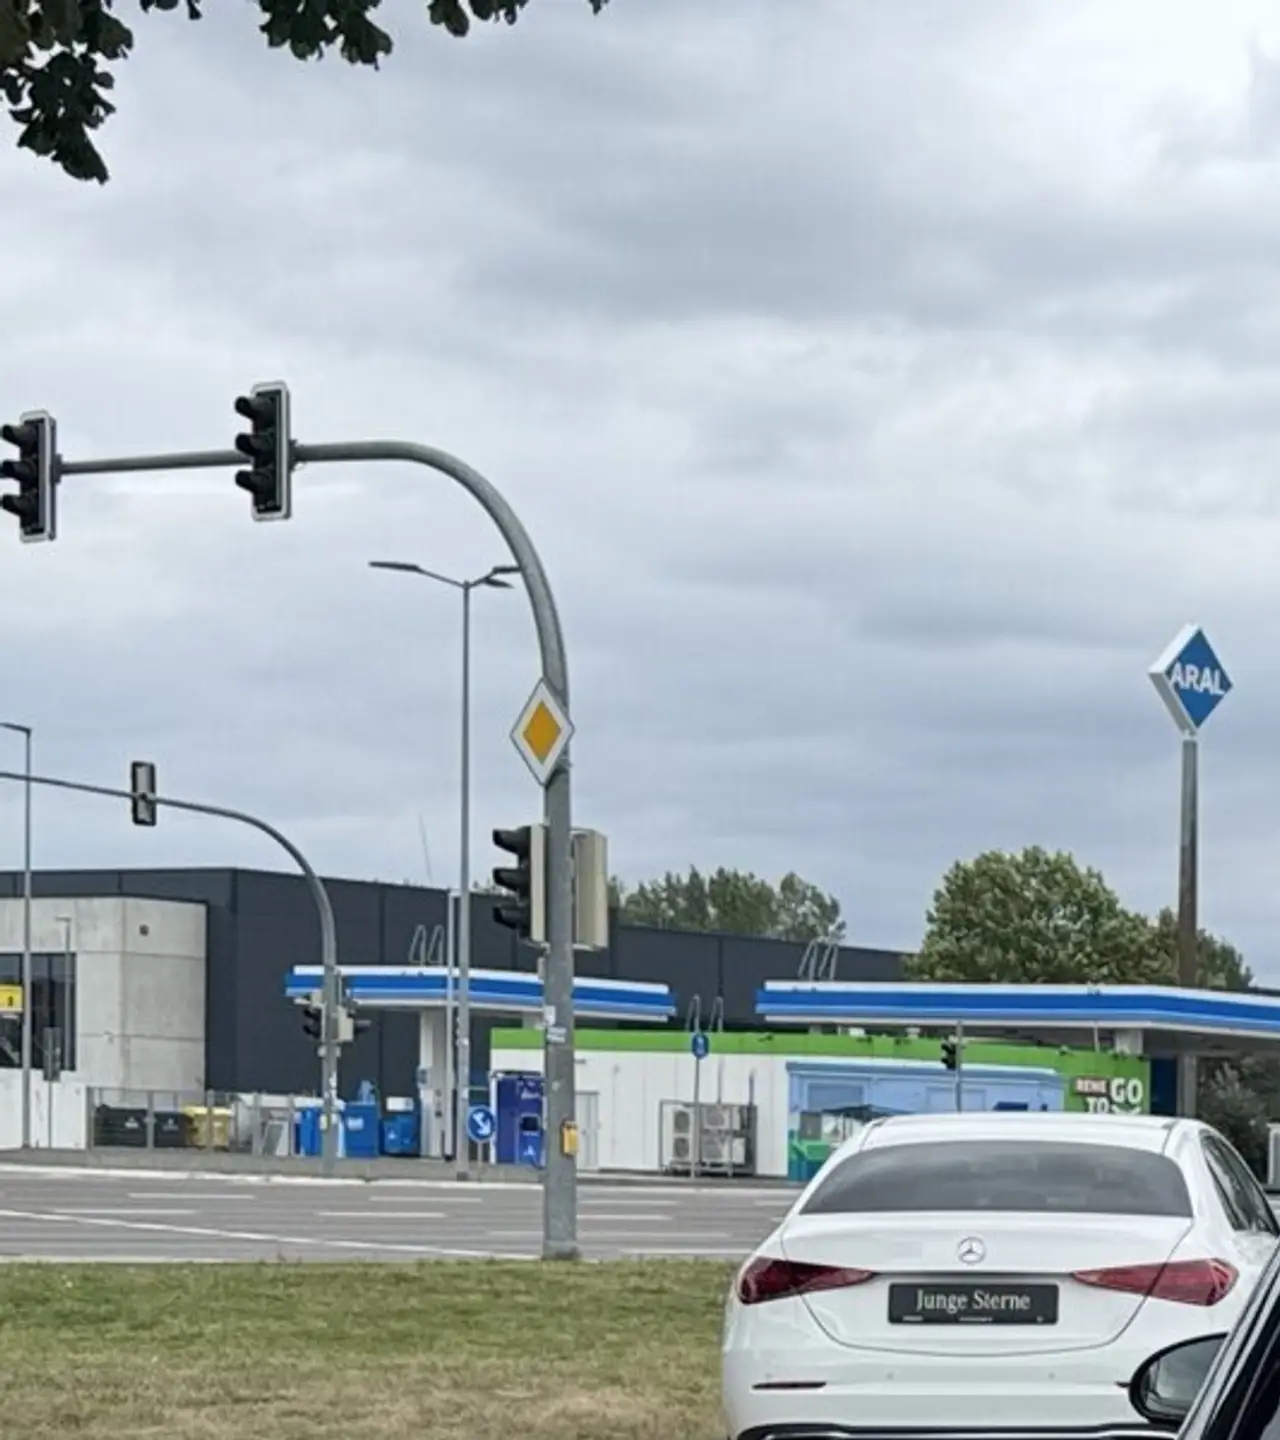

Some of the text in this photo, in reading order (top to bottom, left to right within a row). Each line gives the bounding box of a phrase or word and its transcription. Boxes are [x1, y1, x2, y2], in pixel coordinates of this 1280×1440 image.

[1169, 661, 1225, 695] ARAL
[1110, 1076, 1143, 1105] GO
[1085, 1096, 1110, 1113] TO
[916, 1288, 1031, 1314] Junge Sterne
